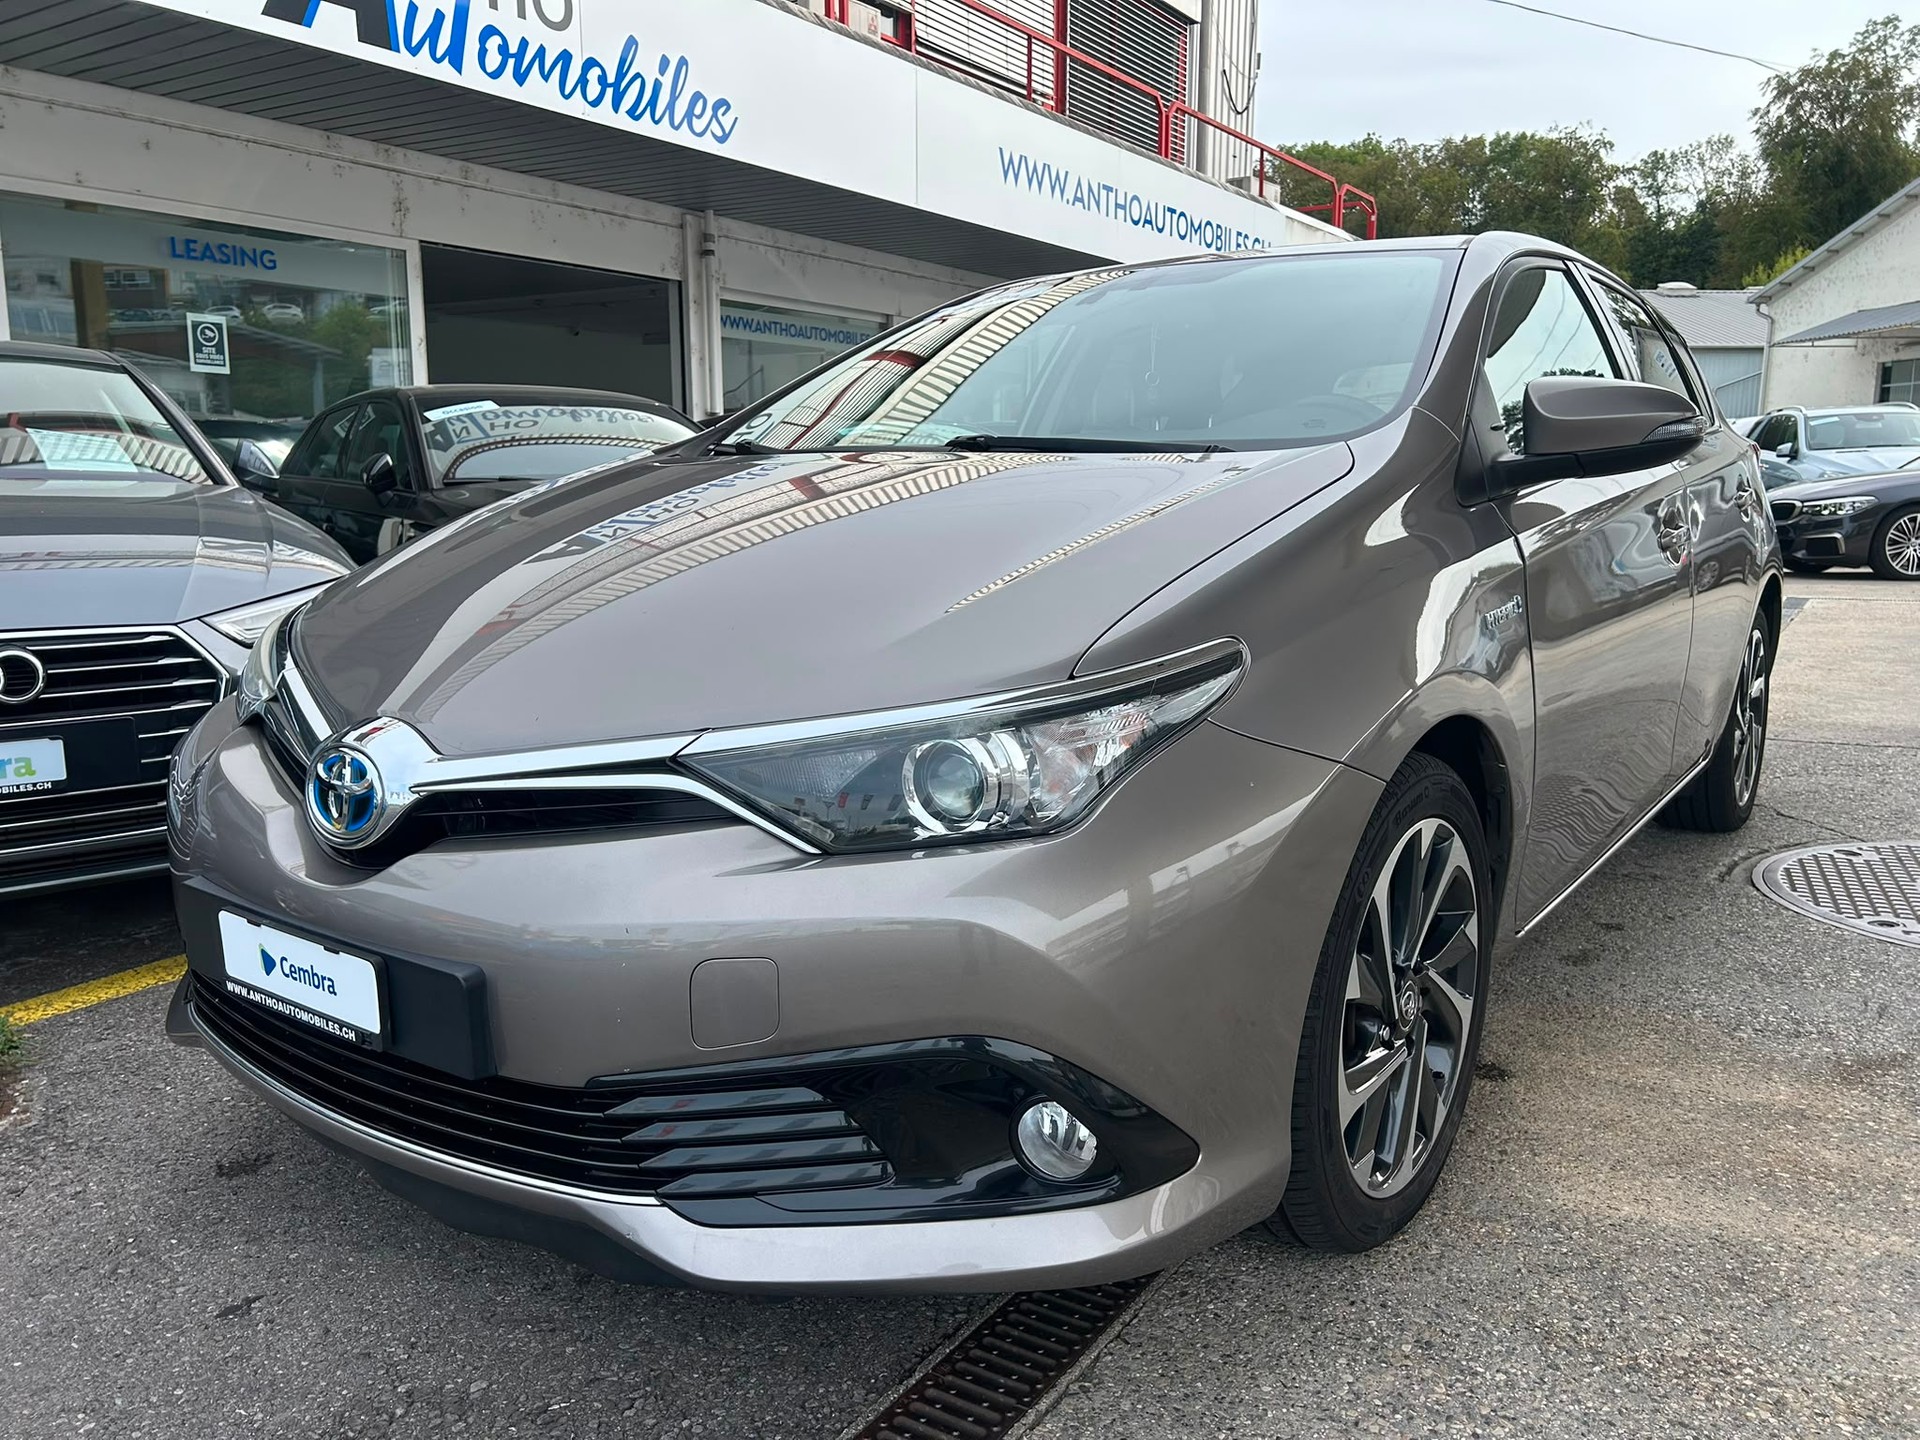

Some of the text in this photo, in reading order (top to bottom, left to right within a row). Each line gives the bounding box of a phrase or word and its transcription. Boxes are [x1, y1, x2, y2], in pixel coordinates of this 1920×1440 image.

[999, 146, 1271, 252] WWW.ANTHOAUTOMOBILES
[169, 236, 277, 270] LEASING
[0, 781, 52, 794] BILES.CH
[280, 956, 338, 997] Cembra
[226, 980, 356, 1042] WWW.ANTHOAUTOMOBILES.CH
